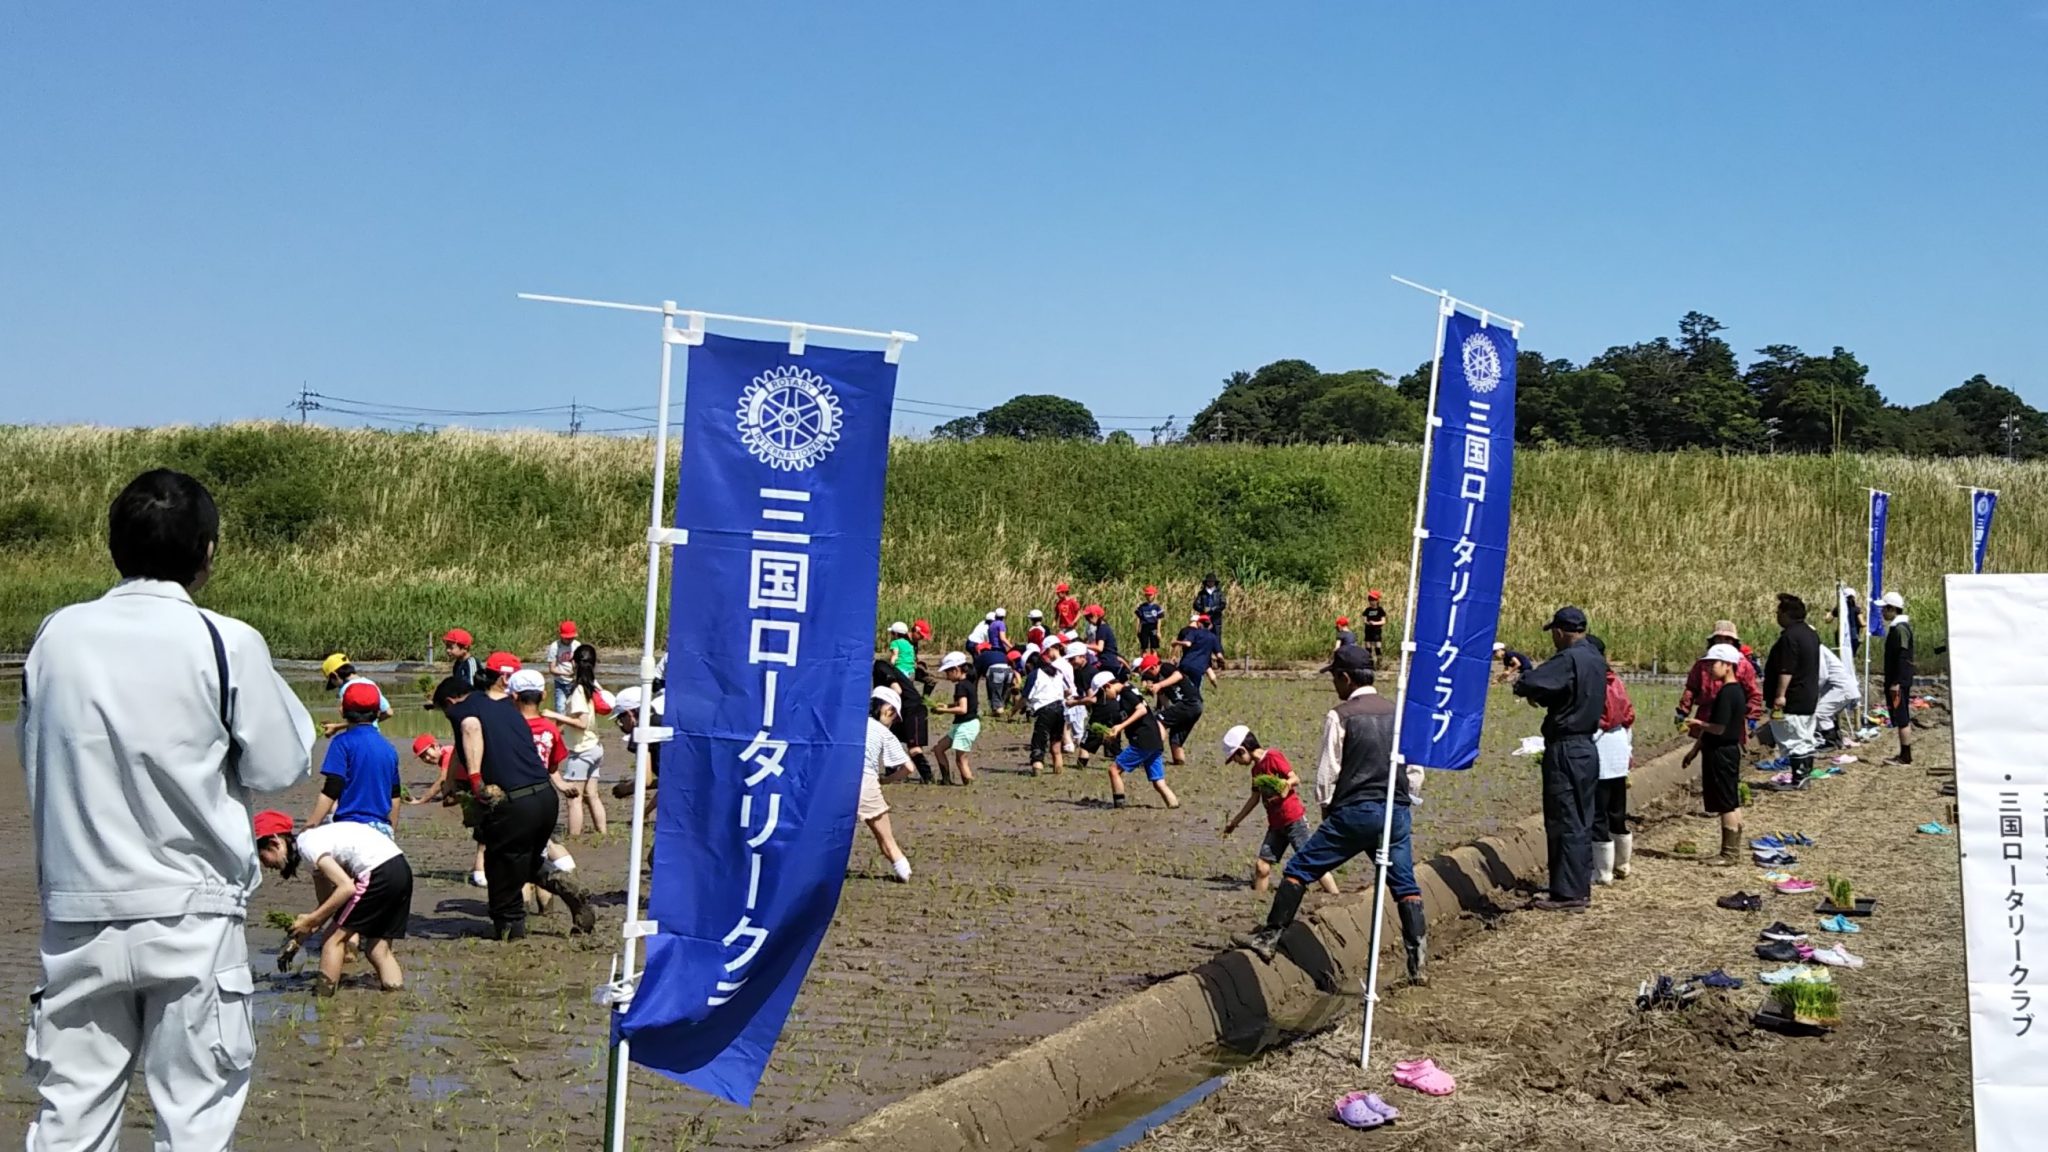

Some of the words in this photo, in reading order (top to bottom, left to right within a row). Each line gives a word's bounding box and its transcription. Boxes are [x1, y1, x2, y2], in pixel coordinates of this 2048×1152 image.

[771, 378, 814, 392] ROTARY
[754, 431, 826, 459] INTERNATIONAL
[1431, 400, 1490, 743] 三国ロータリークラブ
